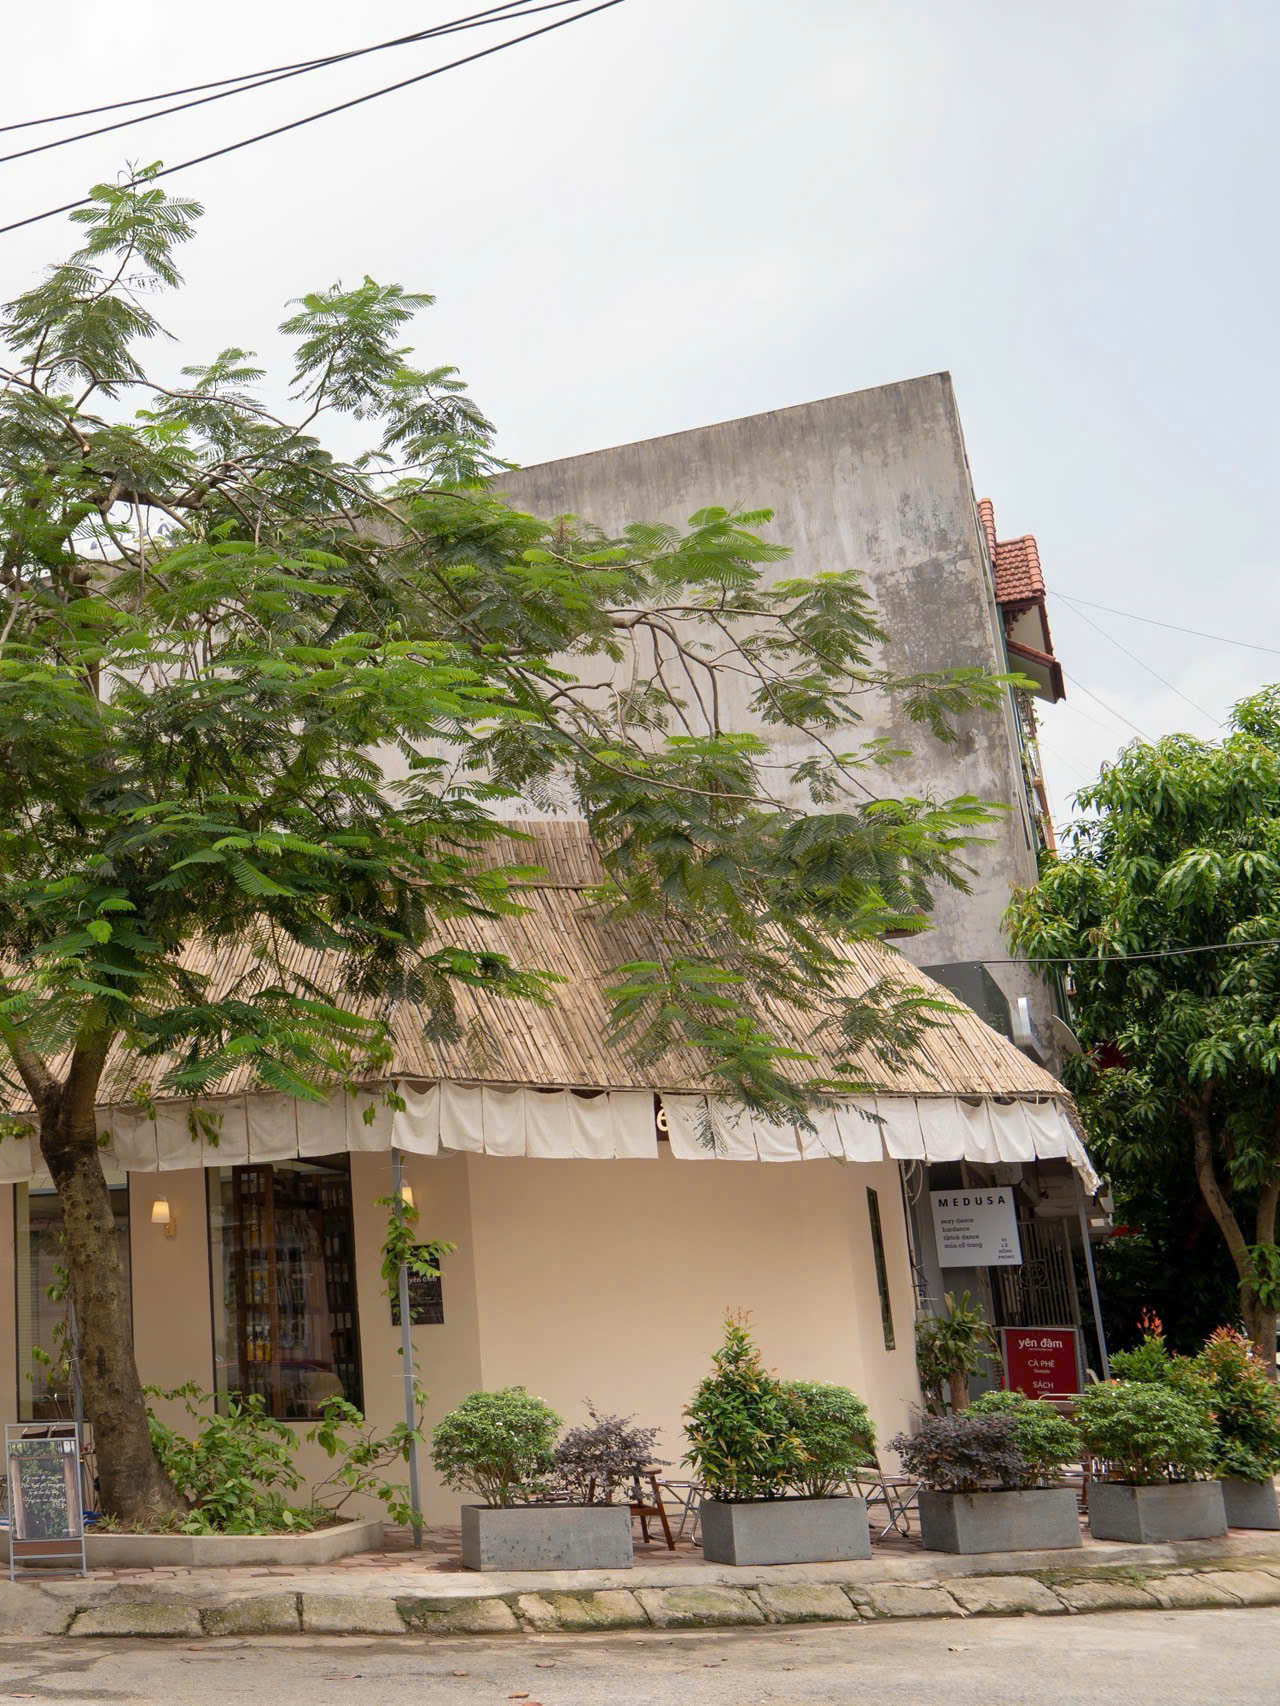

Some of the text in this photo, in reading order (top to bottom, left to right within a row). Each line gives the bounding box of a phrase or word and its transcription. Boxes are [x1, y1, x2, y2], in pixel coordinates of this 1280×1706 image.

[938, 1195, 1006, 1208] MEDUSA
[1018, 1337, 1063, 1350] yên đàm
[1032, 1380, 1054, 1389] SÁCH
